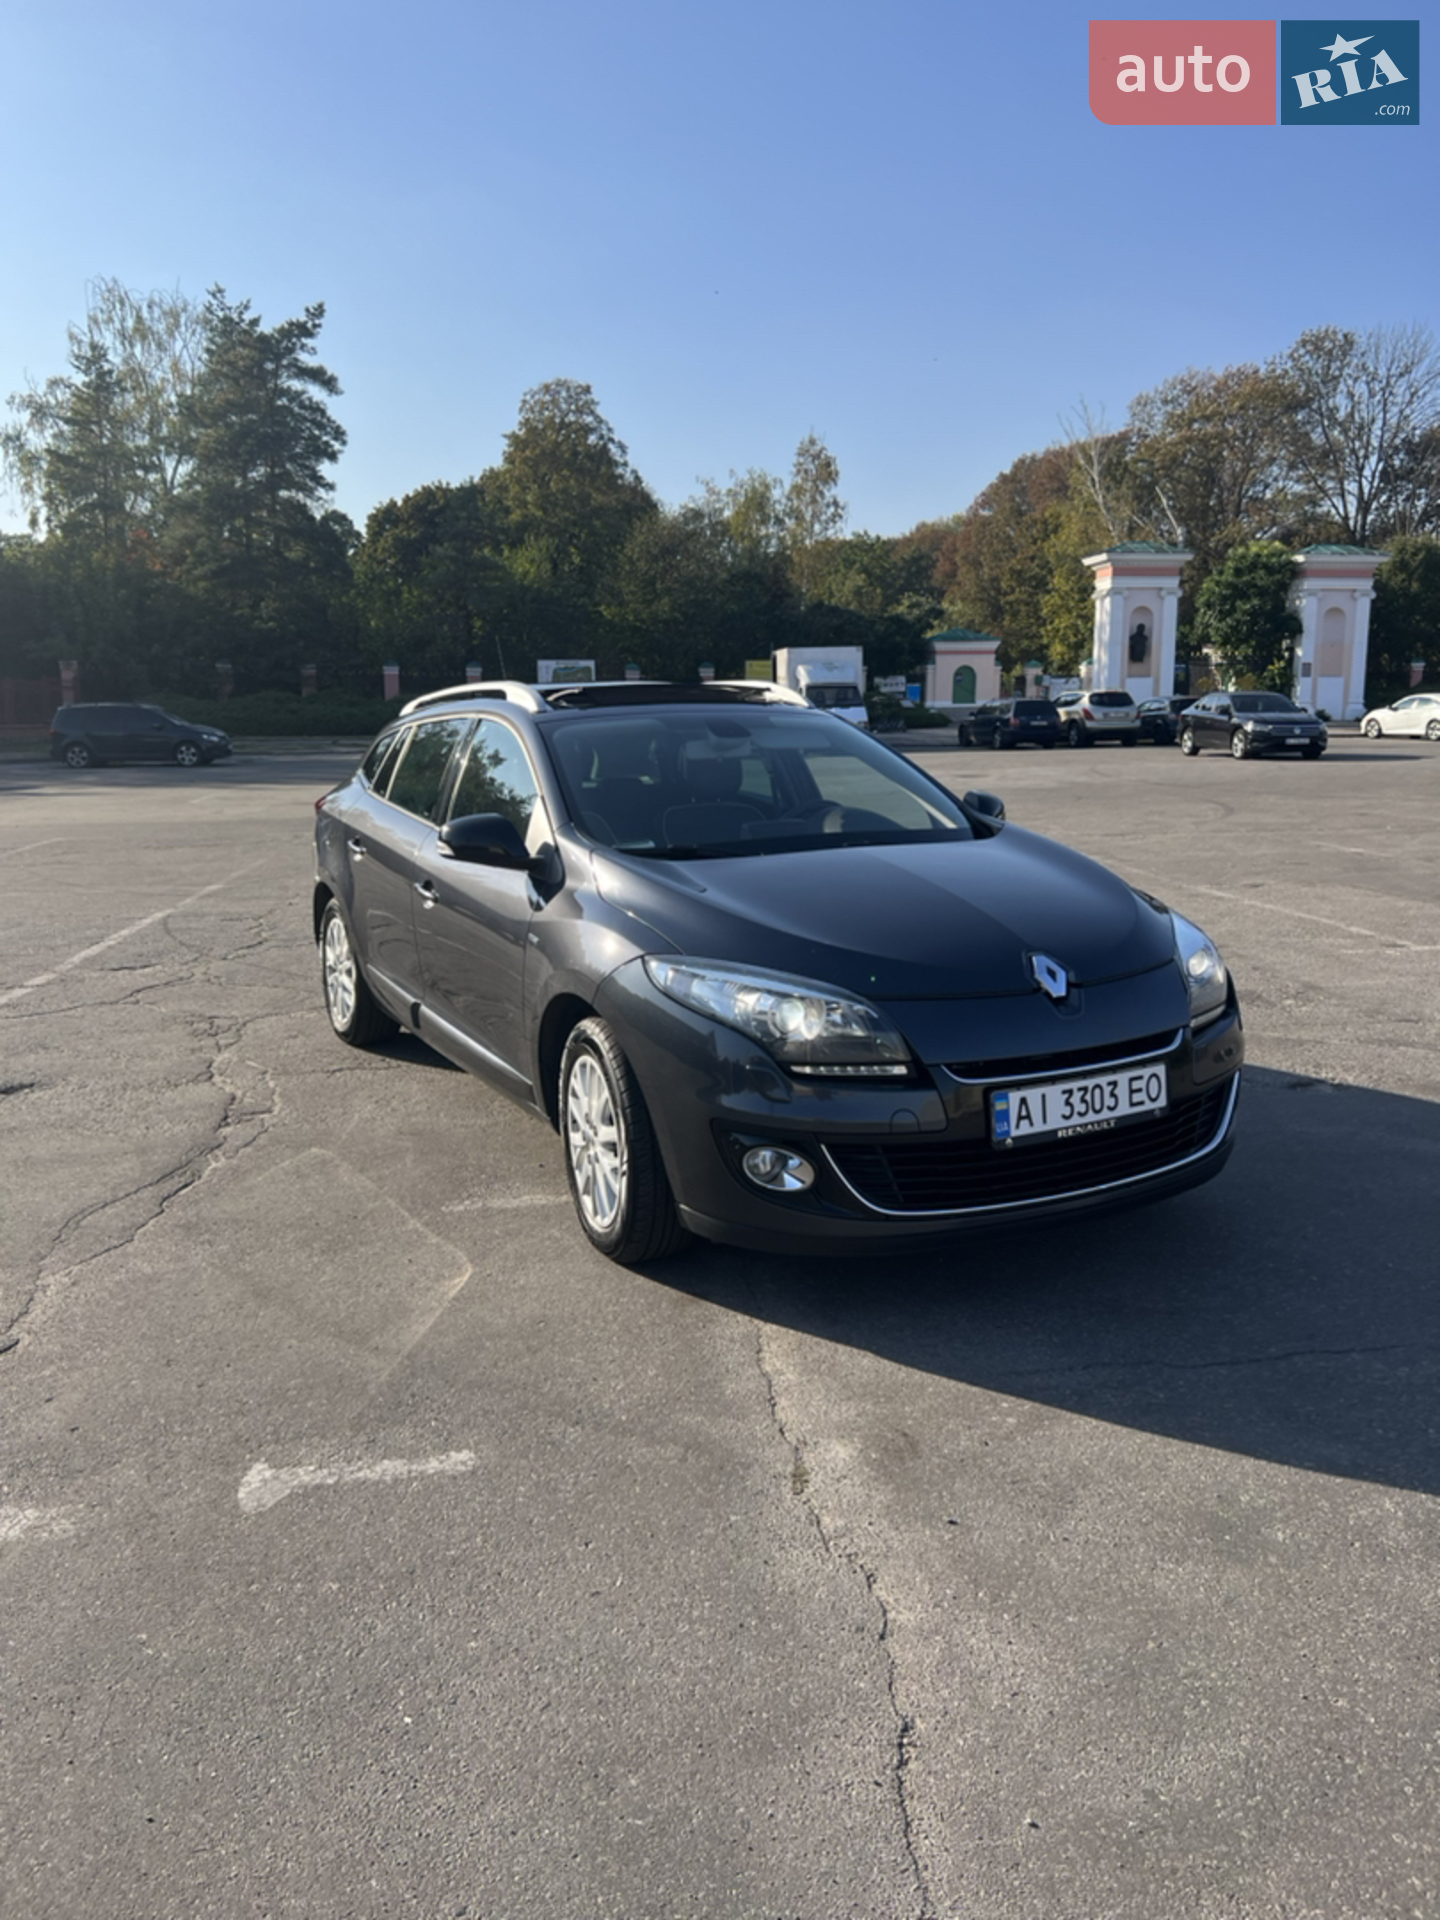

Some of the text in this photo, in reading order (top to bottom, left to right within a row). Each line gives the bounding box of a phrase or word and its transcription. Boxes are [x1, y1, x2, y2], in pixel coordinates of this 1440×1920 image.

[1014, 1072, 1162, 1130] AI 3303 EO
[1057, 1119, 1117, 1139] RENAULT
